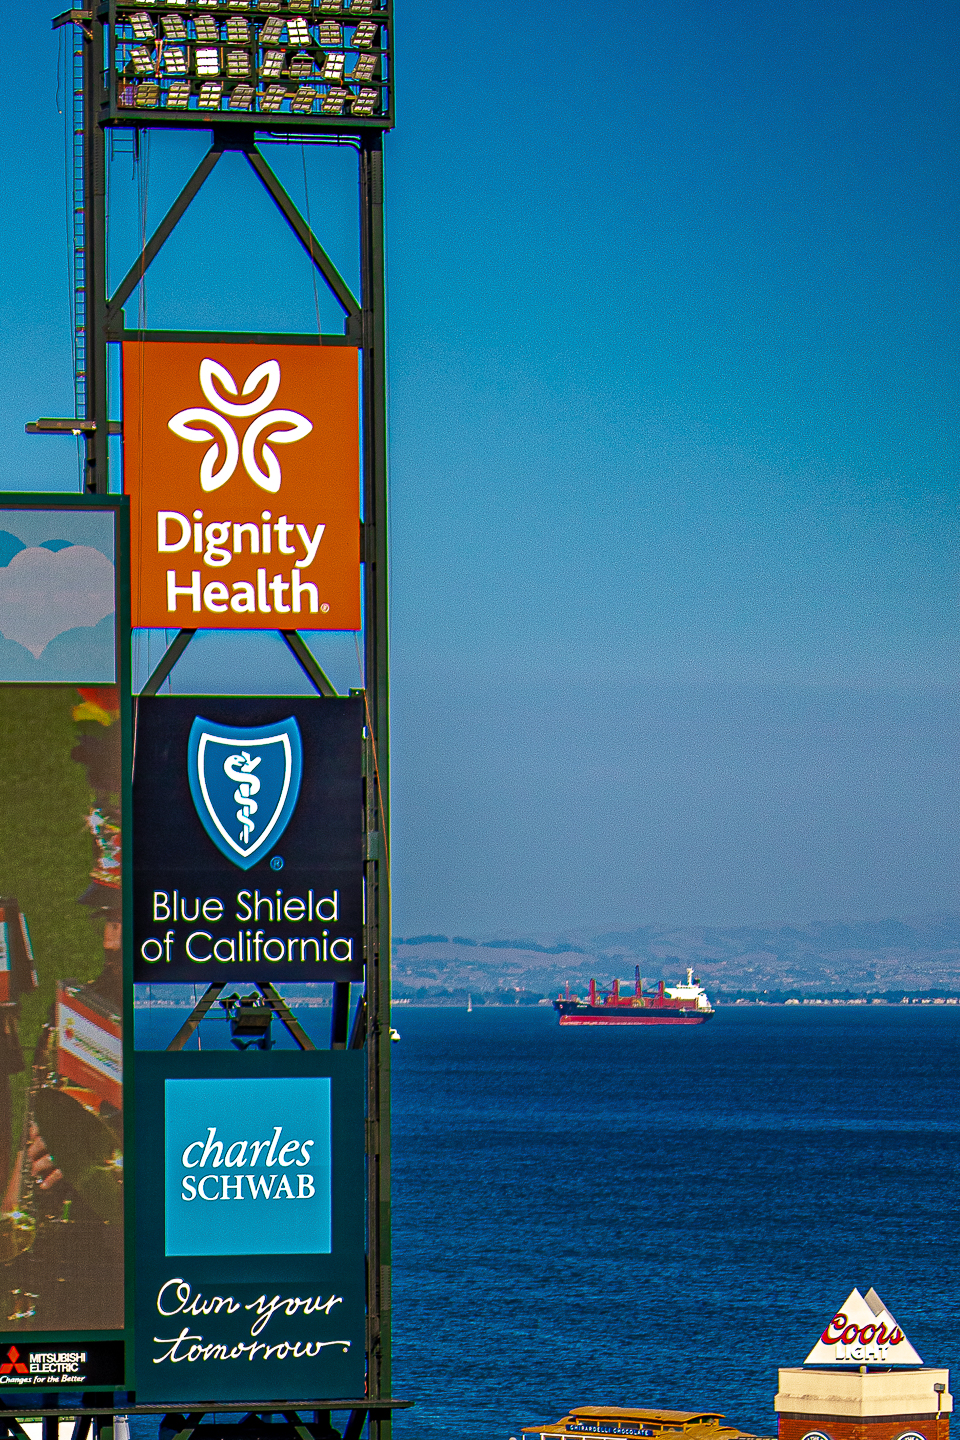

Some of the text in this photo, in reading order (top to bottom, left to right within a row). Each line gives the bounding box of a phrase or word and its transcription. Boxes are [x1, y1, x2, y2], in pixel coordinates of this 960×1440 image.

[157, 508, 326, 568] Dignity
[166, 567, 320, 614] Health
[152, 889, 339, 922] Blue Shield
[140, 930, 354, 963] of California
[181, 1127, 315, 1169] charles
[181, 1174, 316, 1202] SCHWAB
[156, 1277, 343, 1336] Own your
[821, 1313, 905, 1346] Coors
[29, 1352, 86, 1364] MITSUBISHI
[29, 1363, 79, 1373] ELECTRIC
[835, 1344, 889, 1361] LIGHT
[0, 1375, 86, 1385] Changes for the Better
